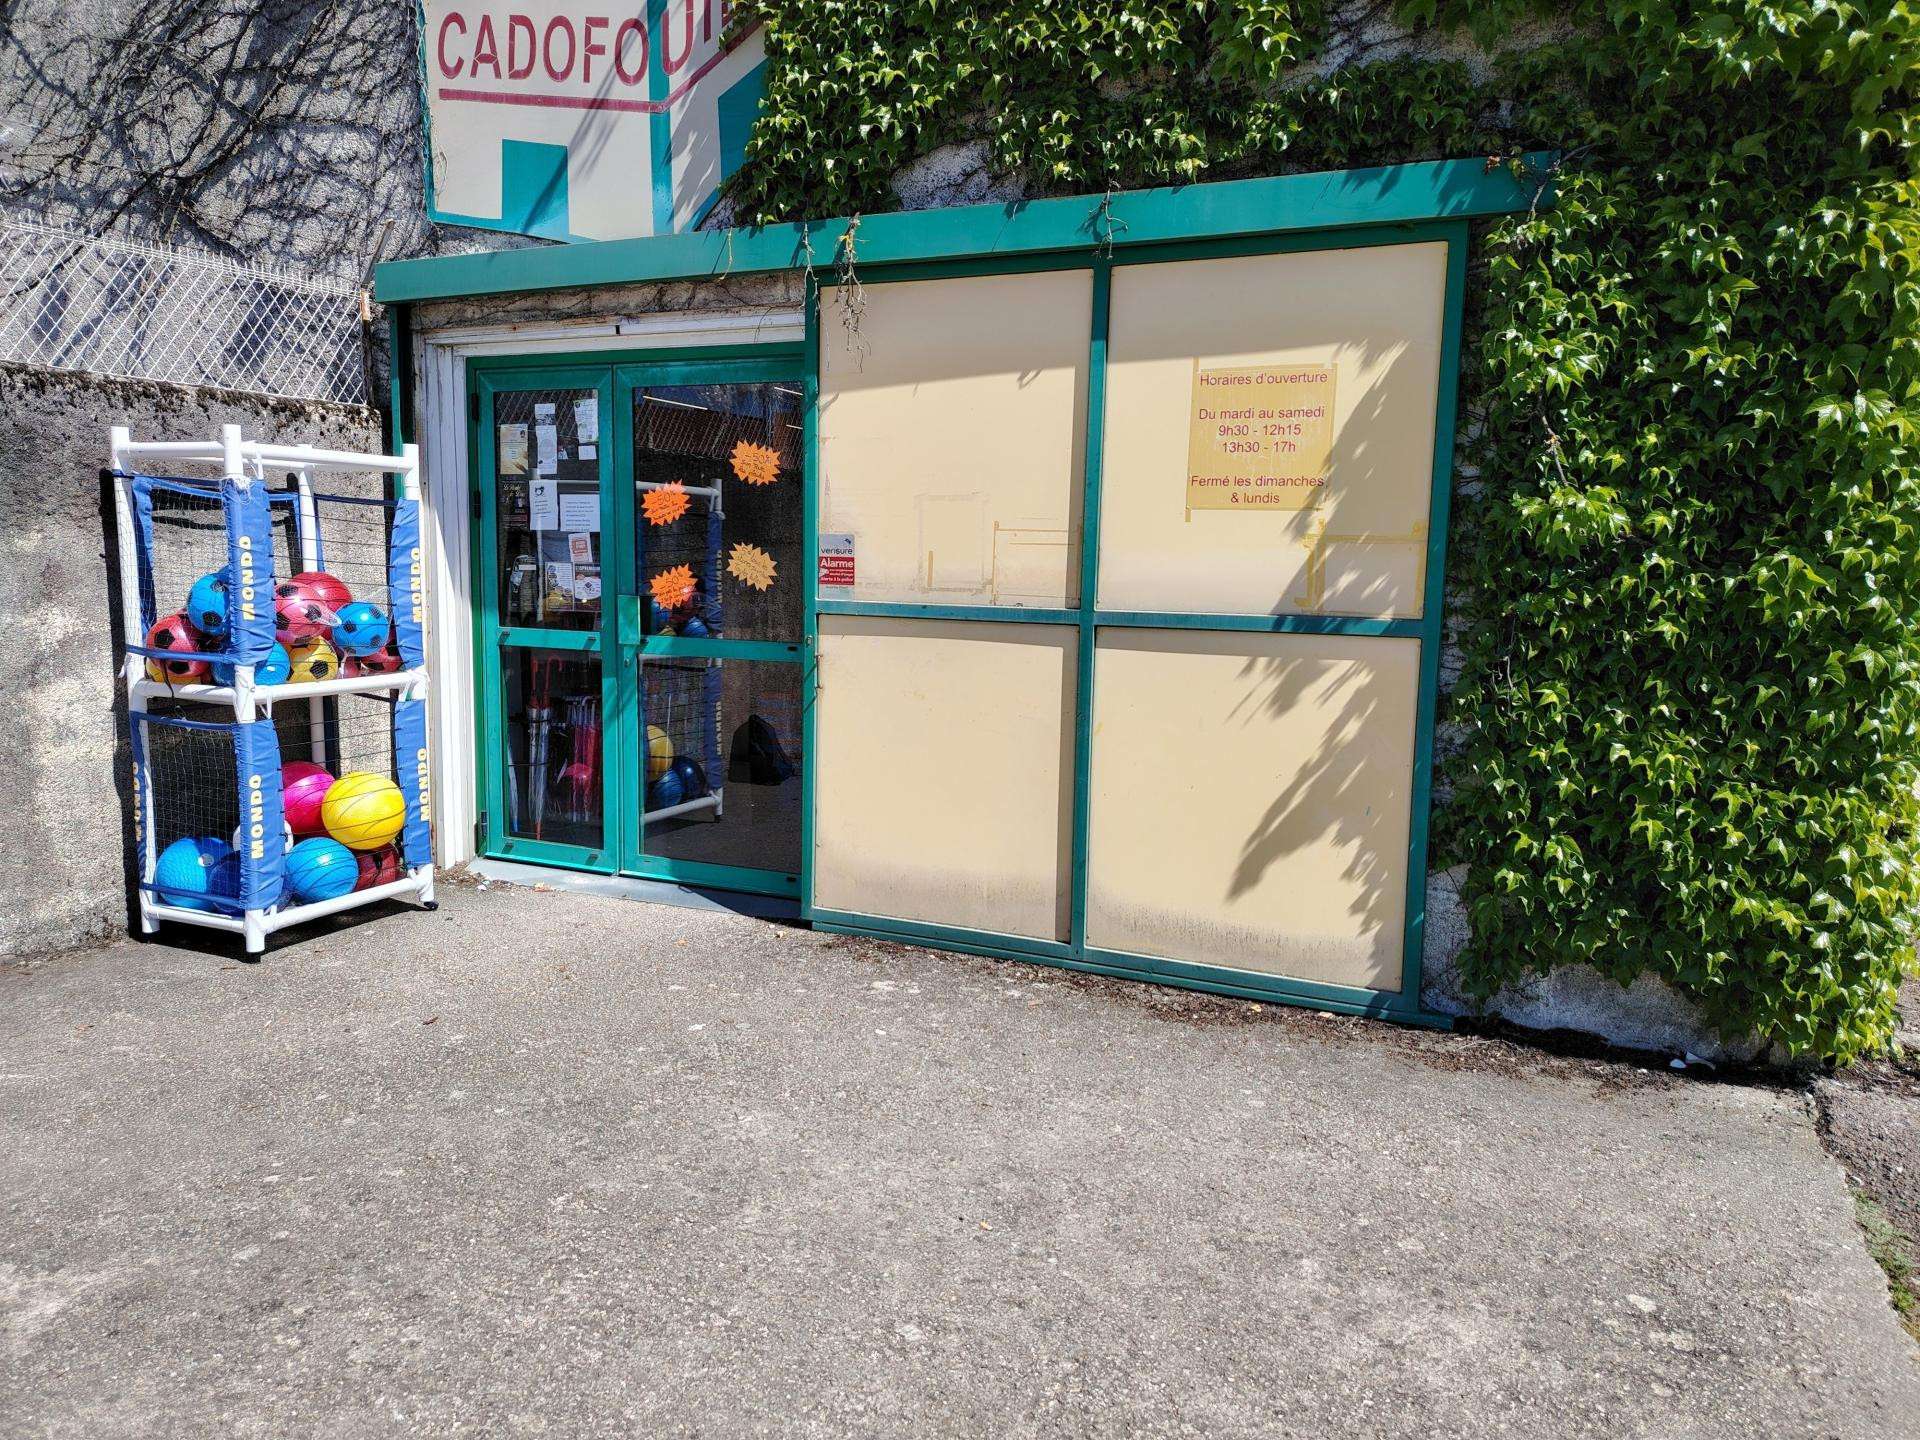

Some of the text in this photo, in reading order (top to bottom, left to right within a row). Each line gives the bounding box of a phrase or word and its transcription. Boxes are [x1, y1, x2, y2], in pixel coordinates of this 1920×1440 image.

[1200, 372, 1328, 386] Horaires d'ouverture
[1199, 406, 1325, 420] Du mardi au samedi
[1218, 425, 1249, 436] 9h30
[1262, 424, 1302, 436] 12h15
[1222, 441, 1260, 453] 13h30
[1273, 441, 1296, 453] 17h
[1191, 475, 1324, 487] Fermé les dimanches
[1230, 492, 1280, 504] & lundis
[821, 547, 853, 555] verisure
[820, 558, 854, 568] Alarme
[238, 535, 256, 621] MONDO
[410, 547, 423, 623] MONDO
[416, 748, 431, 822] MONDO
[249, 774, 265, 860] MONDO
